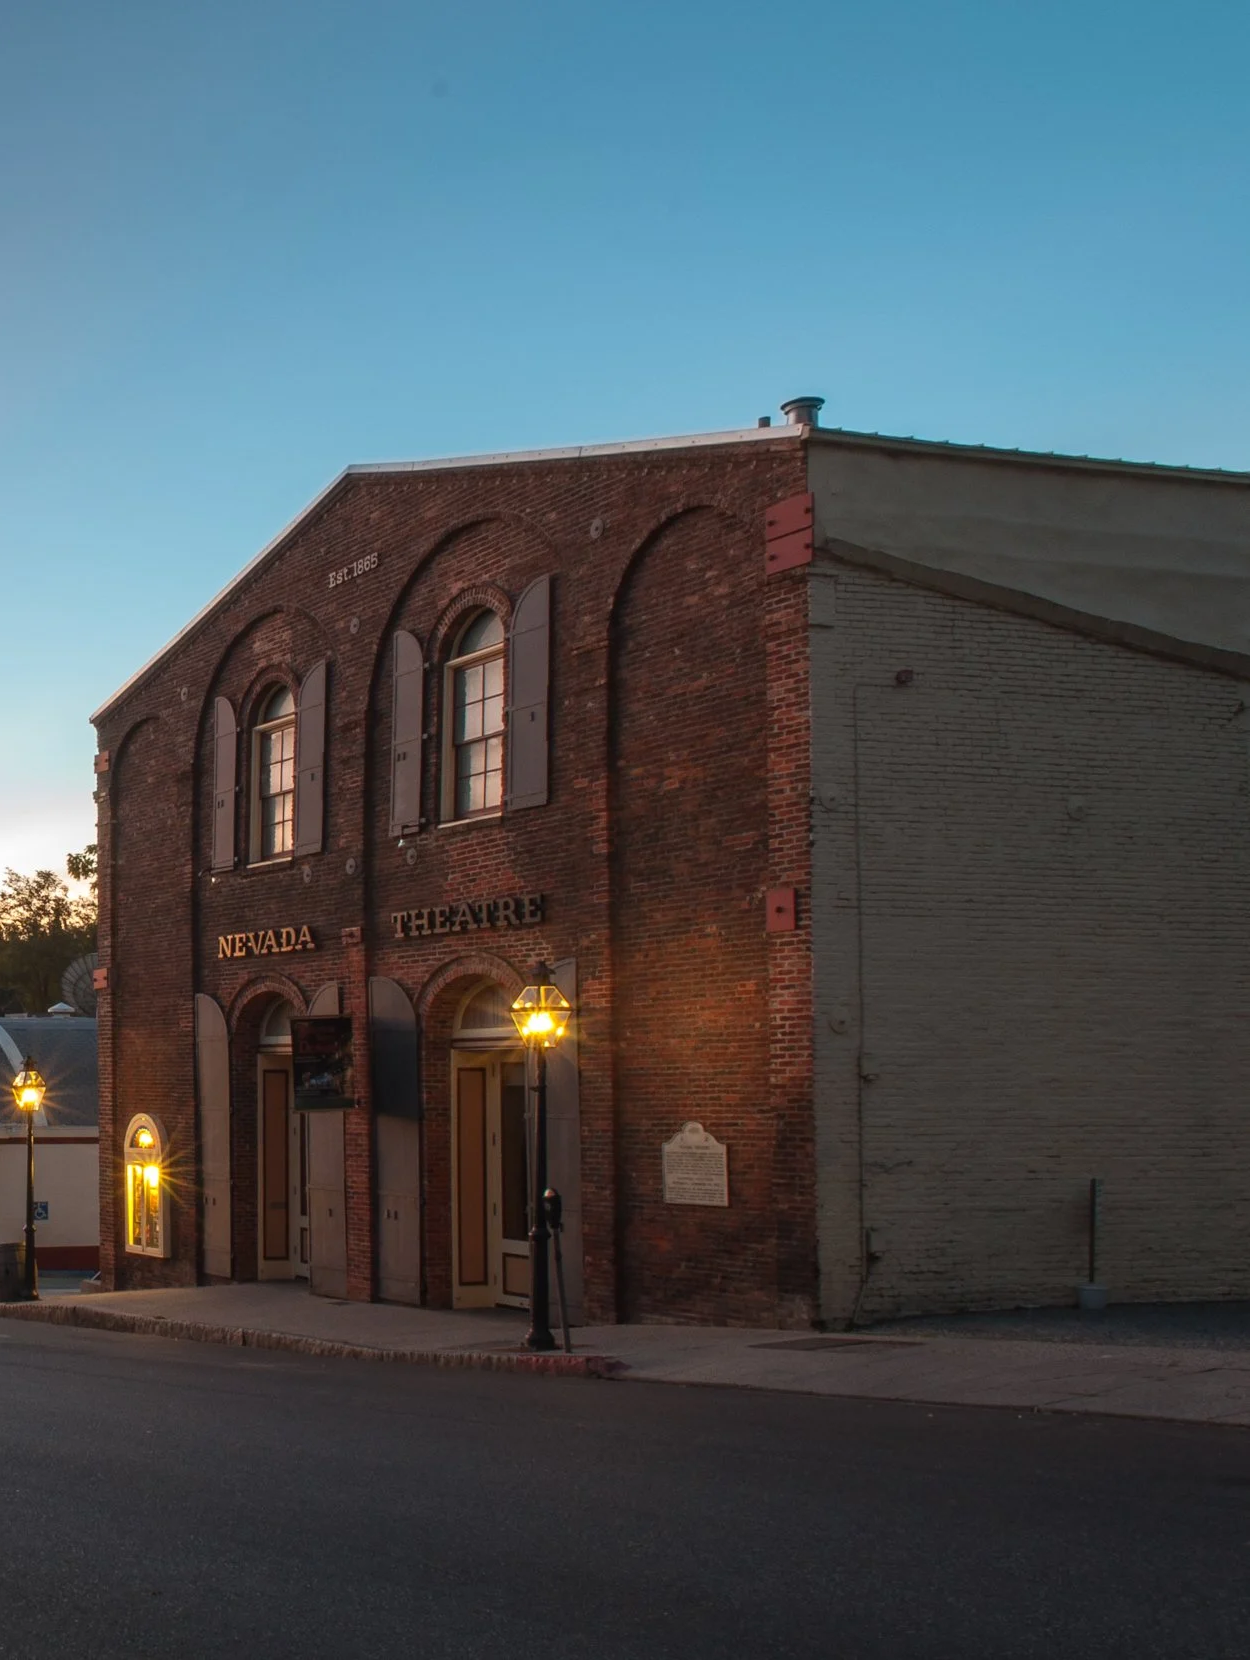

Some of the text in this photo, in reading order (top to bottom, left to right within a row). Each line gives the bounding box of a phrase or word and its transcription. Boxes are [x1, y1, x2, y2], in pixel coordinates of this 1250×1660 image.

[328, 552, 379, 588] Est. 1865
[217, 895, 545, 959] NEVADA THEATRE
